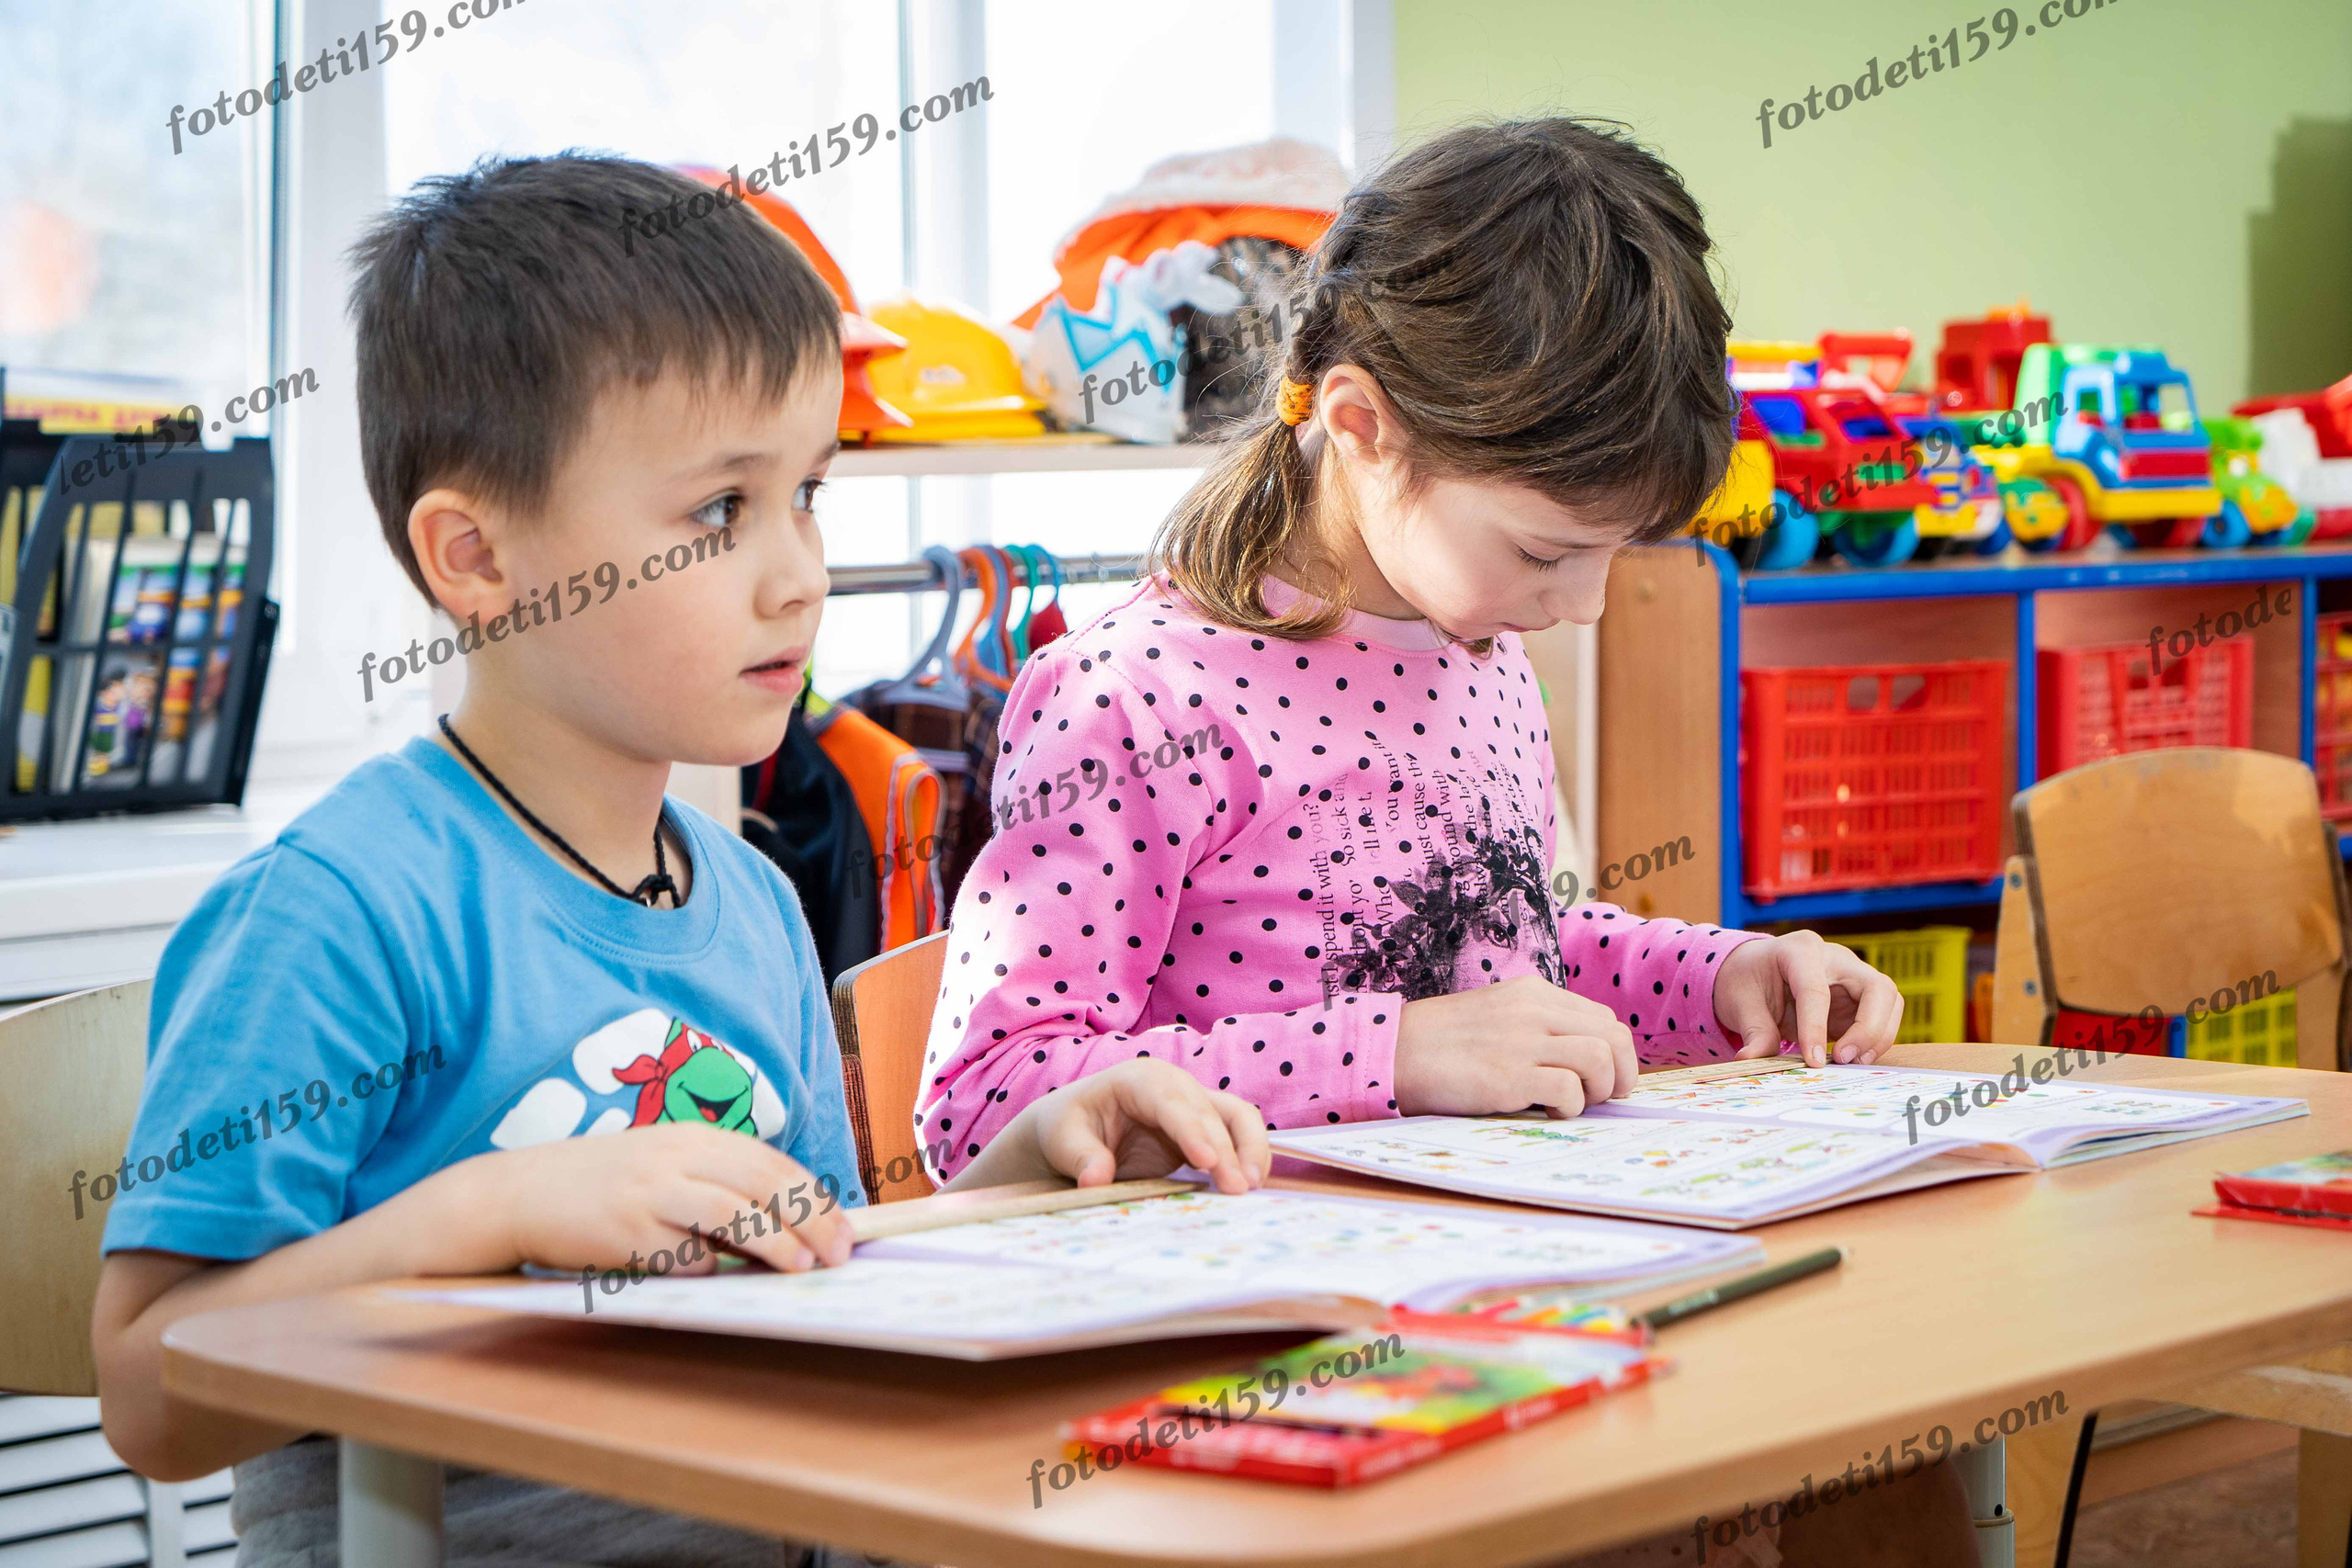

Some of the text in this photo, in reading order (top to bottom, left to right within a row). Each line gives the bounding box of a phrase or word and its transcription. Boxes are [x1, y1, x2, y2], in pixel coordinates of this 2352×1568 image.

[1331, 773, 1348, 801] and
[1431, 769, 1451, 806] with
[1466, 775, 1492, 828] thy're
[1304, 804, 1330, 843] you?
[1331, 807, 1352, 840] sick
[1413, 783, 1428, 829] cause
[1464, 805, 1476, 830] the
[1339, 845, 1356, 866] So
[1418, 835, 1439, 865] just
[1437, 812, 1464, 875] around
[1310, 851, 1331, 889] with
[1317, 894, 1333, 905] it
[1317, 910, 1343, 960] spend
